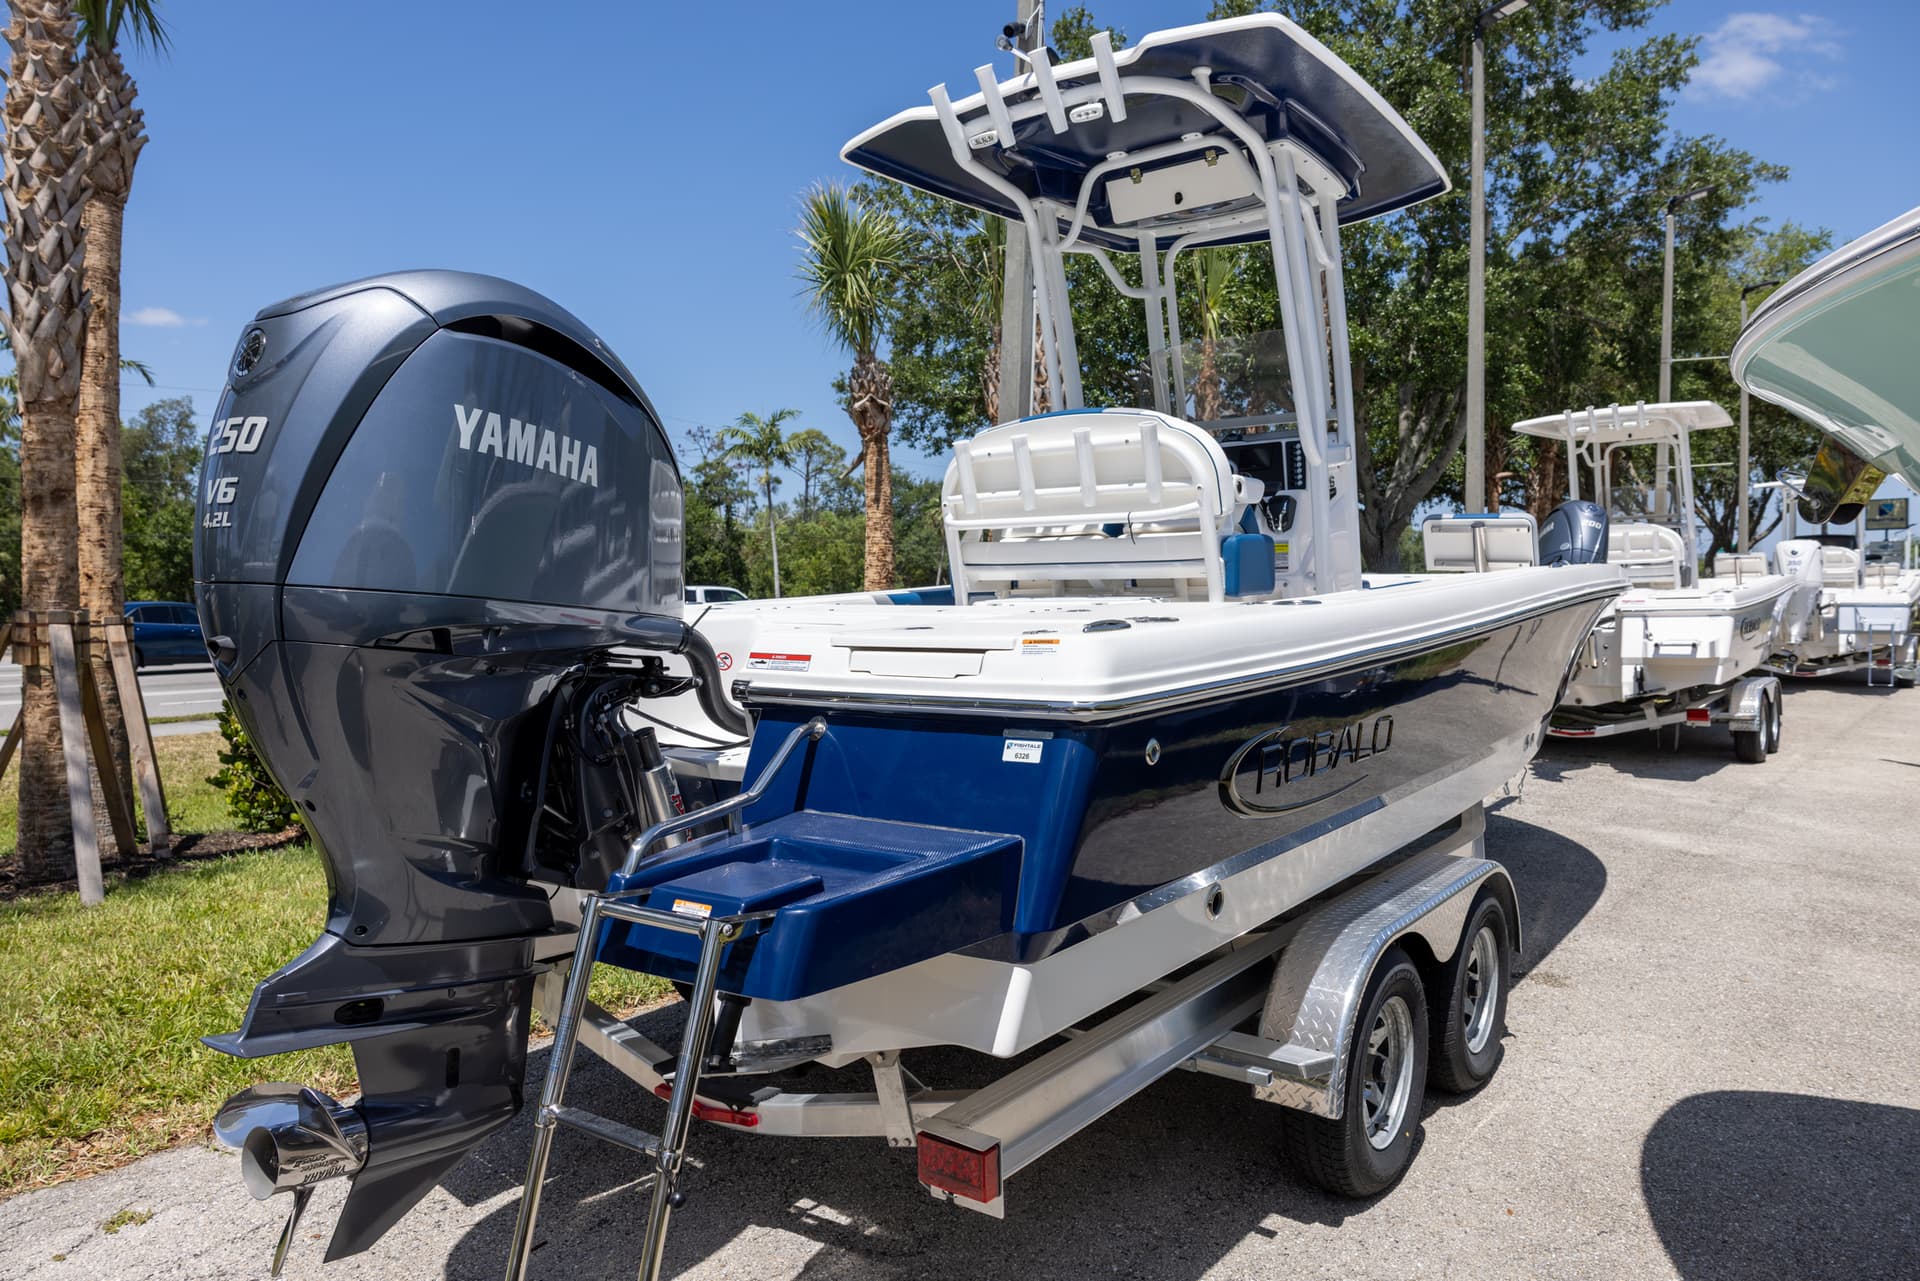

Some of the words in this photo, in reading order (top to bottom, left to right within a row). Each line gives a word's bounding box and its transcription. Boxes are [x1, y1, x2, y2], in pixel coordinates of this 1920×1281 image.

[208, 415, 268, 457] 250
[454, 403, 599, 488] YAMAHA
[206, 476, 239, 505] V6
[202, 511, 232, 529] 4.2L
[1256, 714, 1394, 795] ROBALO
[303, 1164, 346, 1184] YAMAHA
